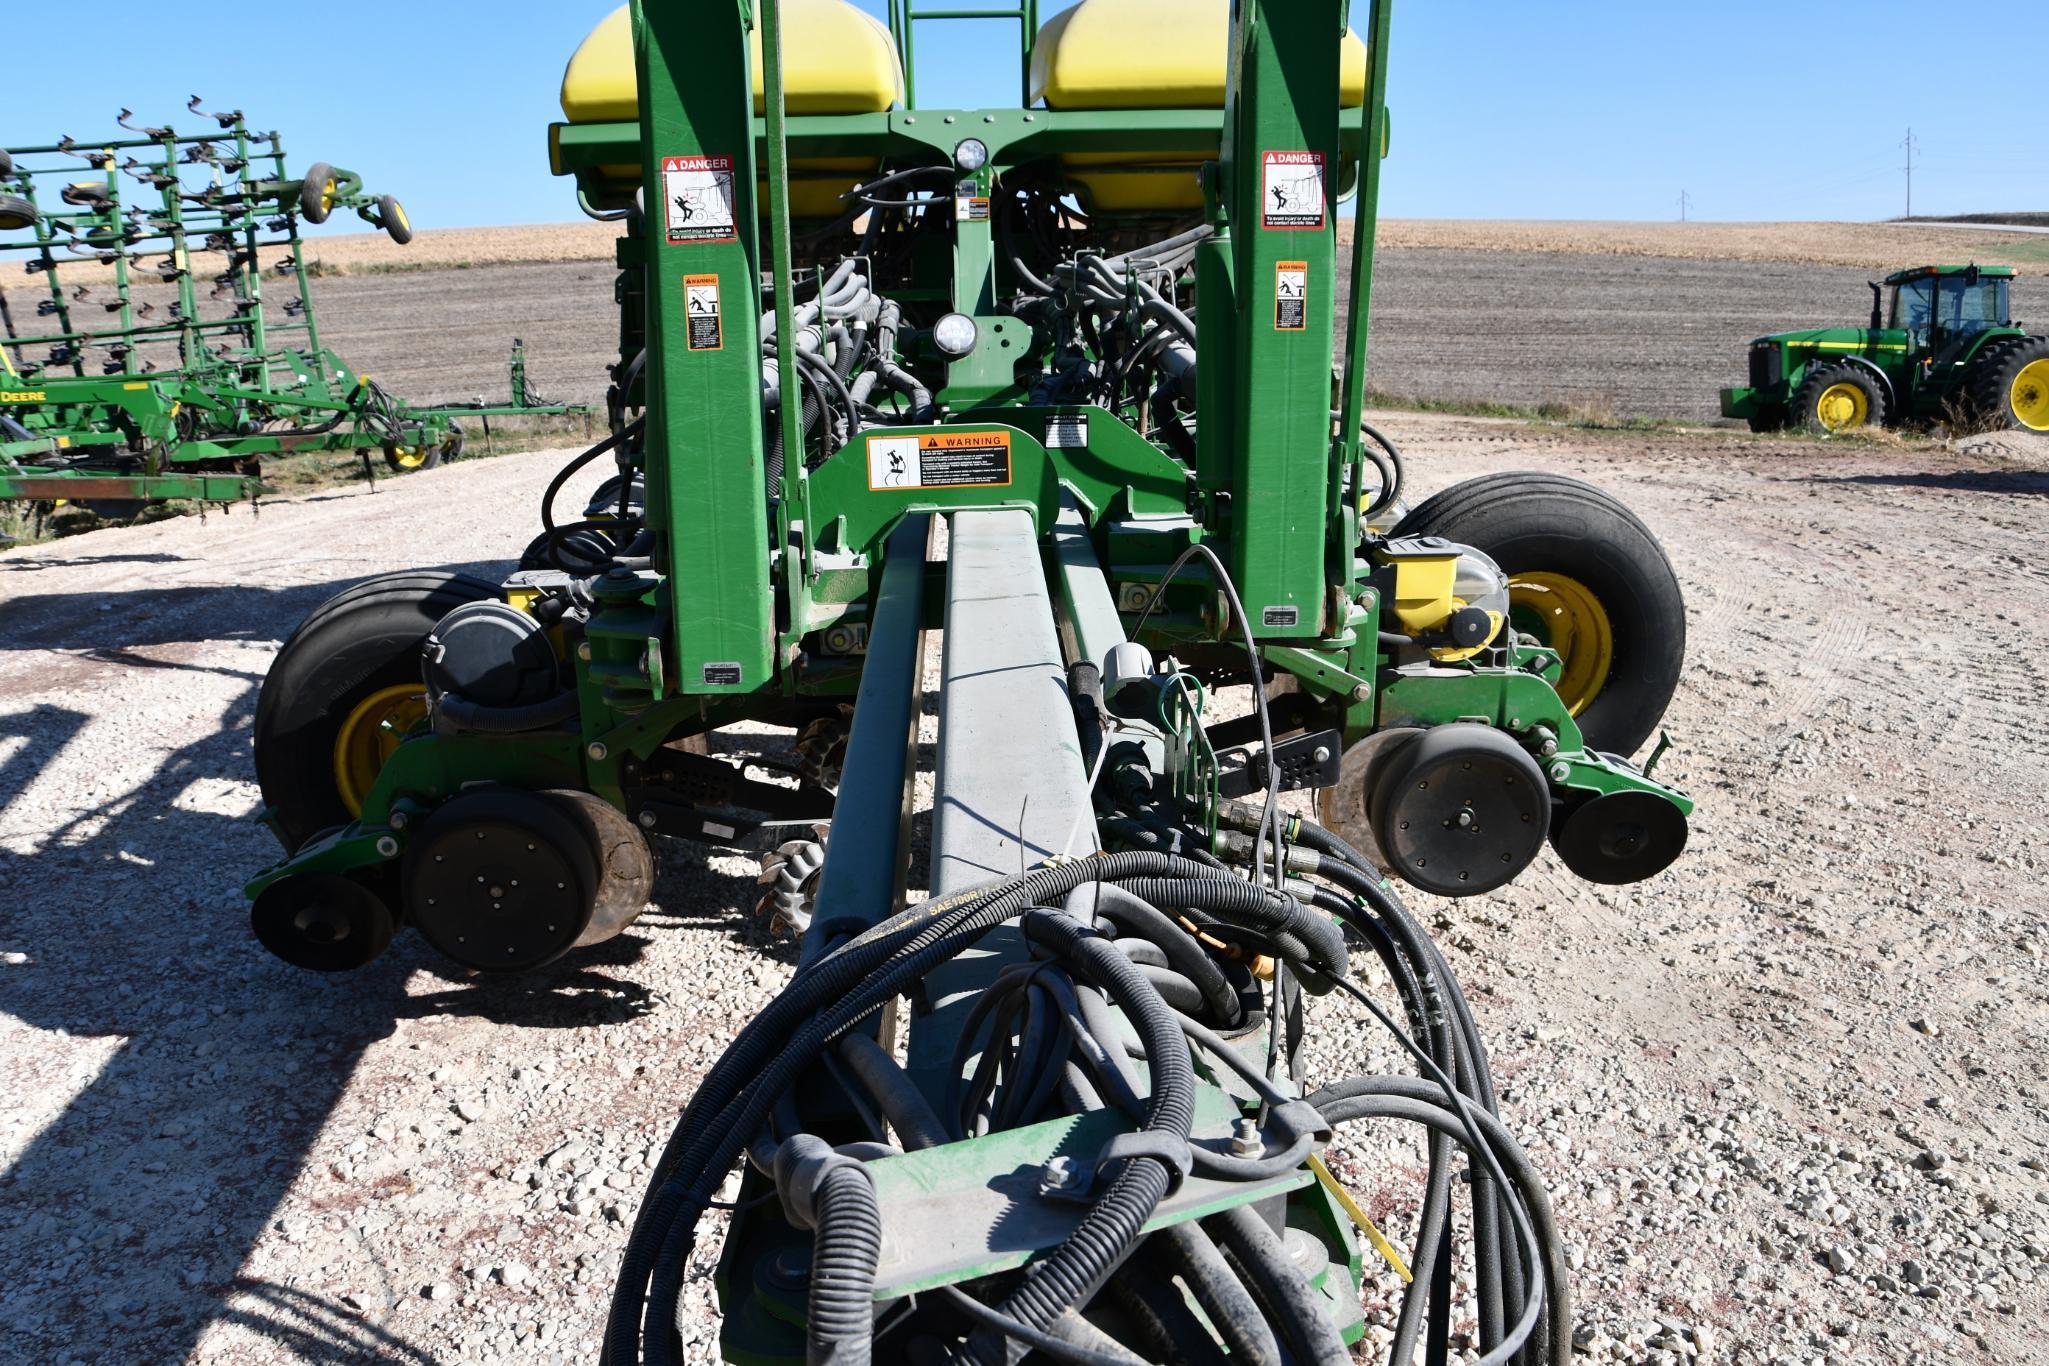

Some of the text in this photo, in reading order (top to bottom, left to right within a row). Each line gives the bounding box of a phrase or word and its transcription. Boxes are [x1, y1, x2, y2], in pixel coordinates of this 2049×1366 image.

[1278, 154, 1320, 163] DANGER
[680, 159, 728, 170] DANGER
[1, 391, 47, 402] DEERE
[946, 437, 1001, 446] WARNING
